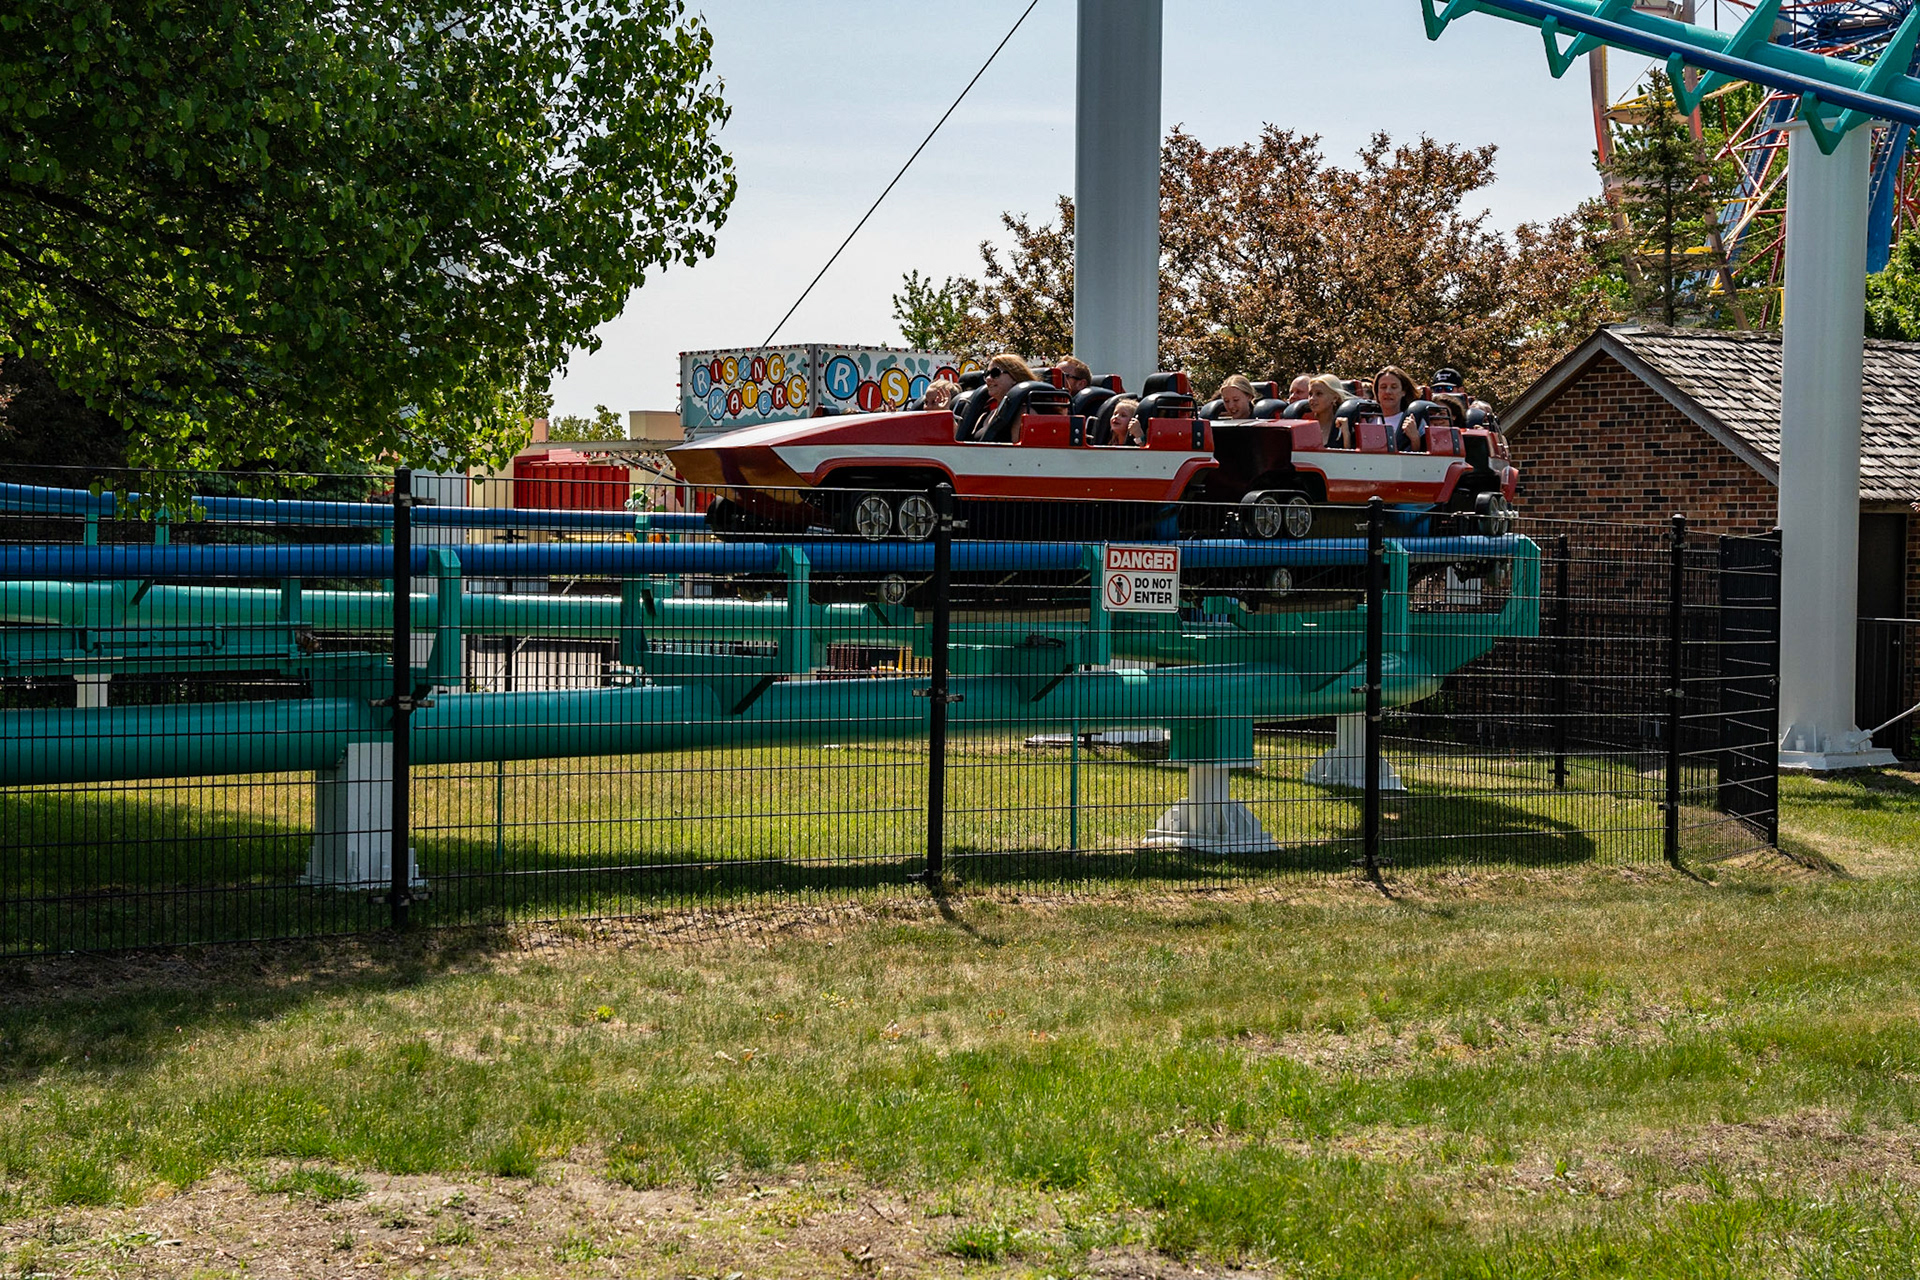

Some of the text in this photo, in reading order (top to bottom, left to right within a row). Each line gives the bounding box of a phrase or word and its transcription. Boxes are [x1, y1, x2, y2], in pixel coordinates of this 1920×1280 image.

[697, 356, 780, 392] RISING
[711, 378, 803, 414] WATERS
[1109, 550, 1175, 570] DANGER
[1134, 577, 1173, 589] DO NOT
[1134, 591, 1172, 604] ENTER
